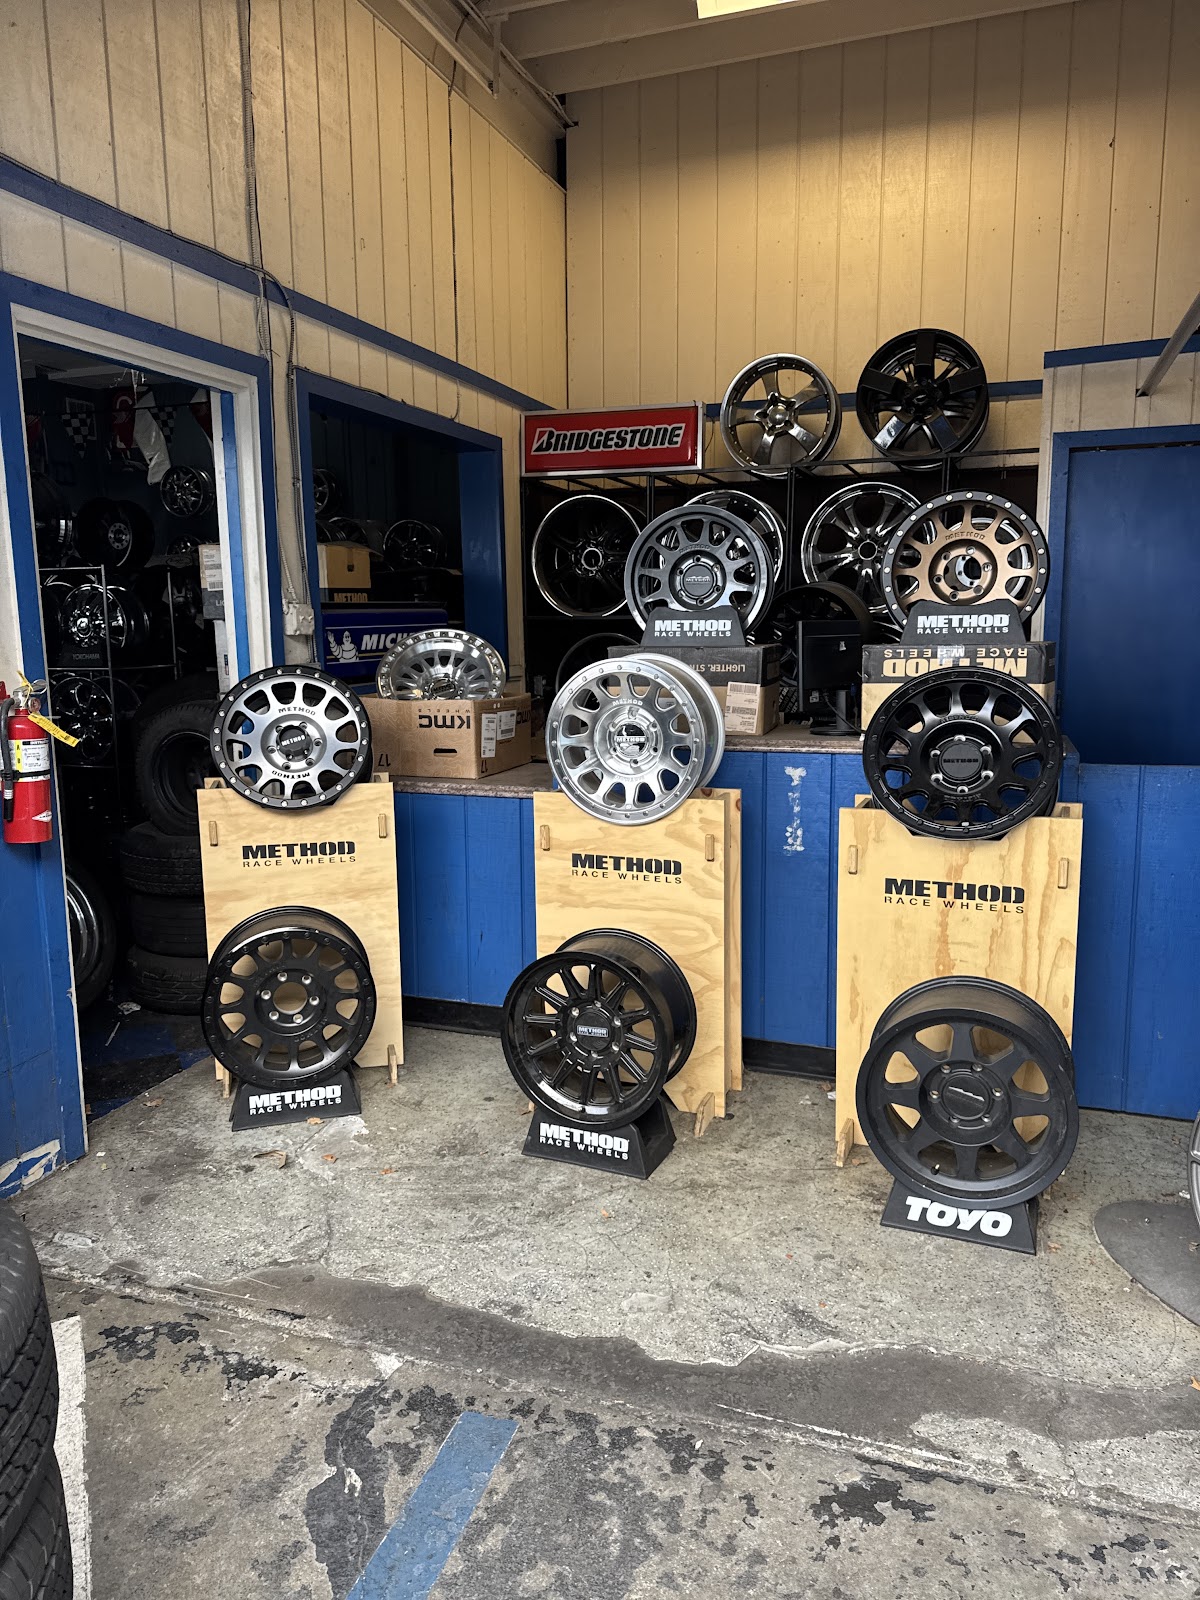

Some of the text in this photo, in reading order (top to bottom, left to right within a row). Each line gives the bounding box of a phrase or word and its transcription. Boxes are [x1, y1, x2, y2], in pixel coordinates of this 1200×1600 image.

[532, 424, 685, 454] BRIDGESTONE
[945, 531, 985, 541] METHOD
[654, 619, 731, 632] METHOD
[917, 614, 1010, 628] METHOD
[956, 626, 1009, 634] WHEELS
[977, 647, 1028, 657] RACE
[612, 698, 643, 706] METHOD
[278, 706, 316, 716] METHOD
[281, 735, 306, 746] METHOD
[378, 753, 391, 767] 17
[271, 770, 311, 779] METHOD
[242, 841, 356, 860] METHOD
[242, 856, 356, 868] RACE WHEELS
[571, 853, 682, 876] METHOD
[571, 869, 682, 884] RACE WHEELS
[884, 877, 1025, 904] METHOD
[884, 896, 1024, 914] RACE WHEELS
[249, 1085, 342, 1109] METHOD
[249, 1097, 342, 1115] RACE WHEELS
[539, 1122, 629, 1152] METHOD
[539, 1136, 629, 1160] RACE WHEELS
[905, 1196, 1013, 1237] TOYO
